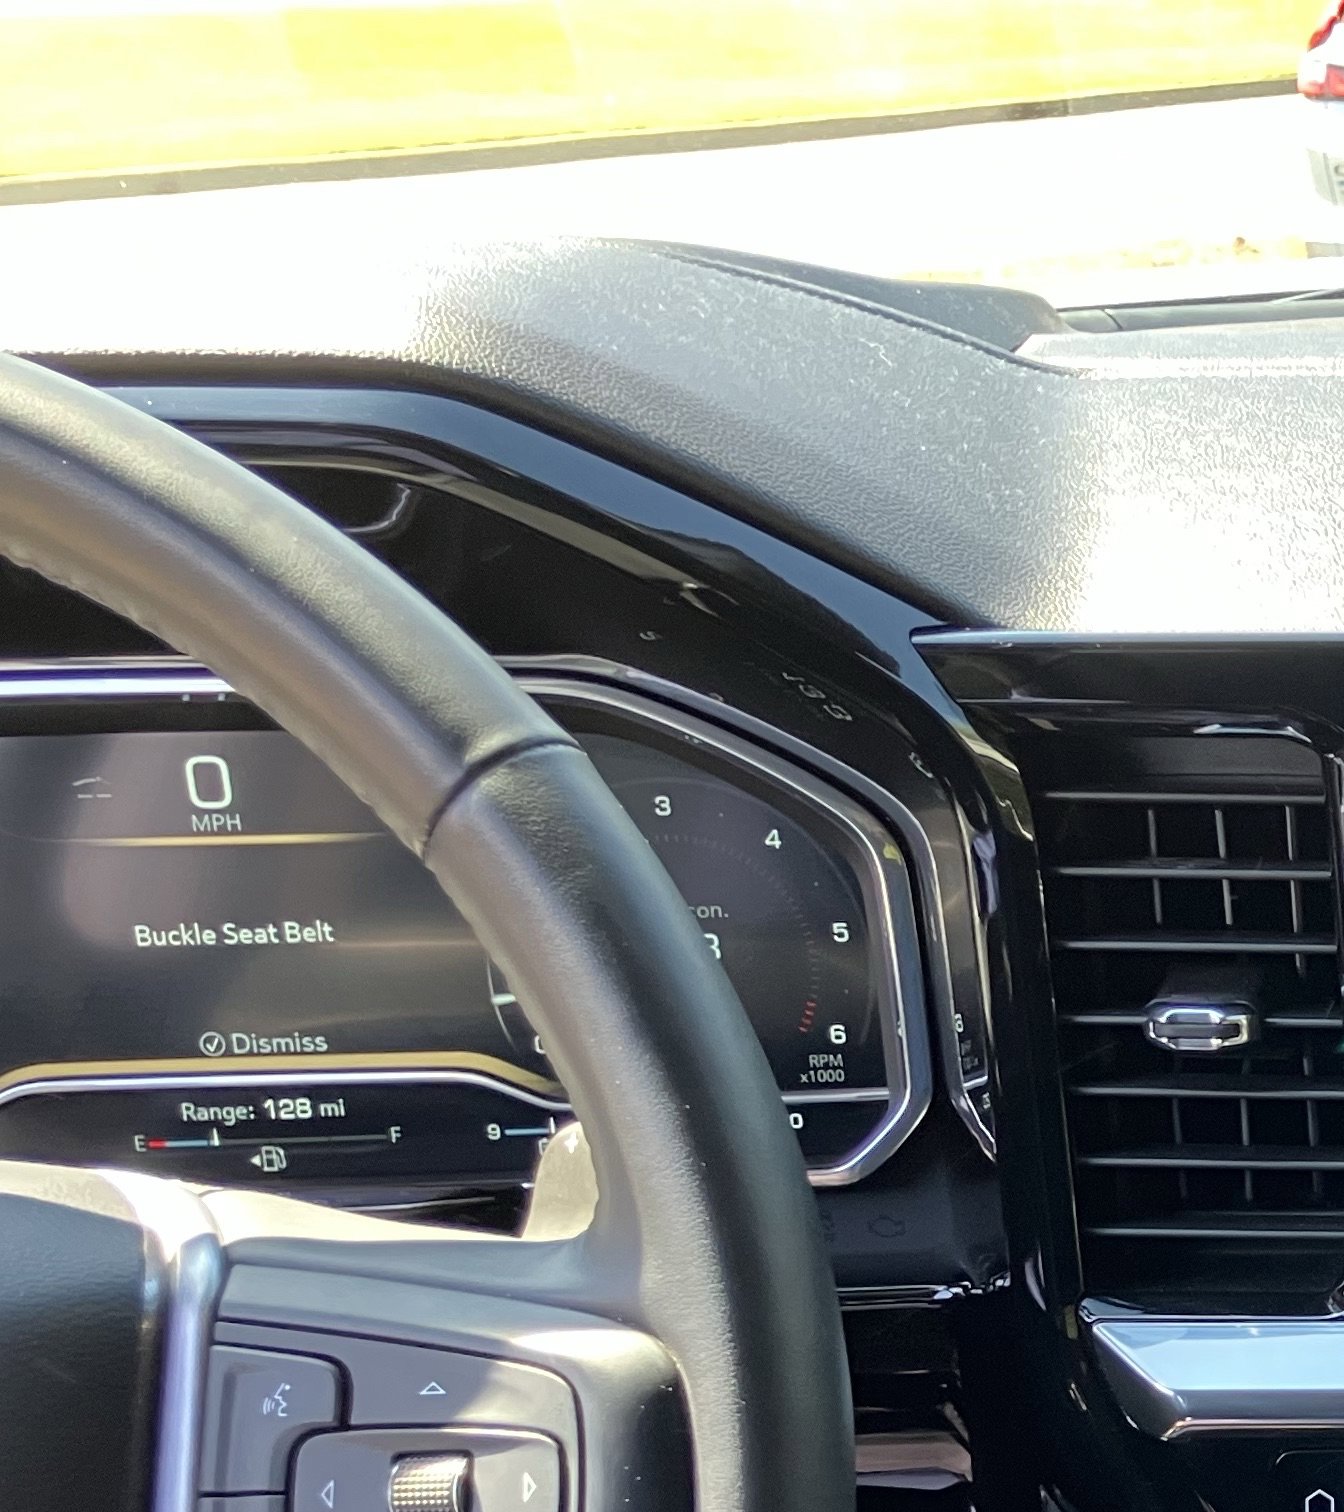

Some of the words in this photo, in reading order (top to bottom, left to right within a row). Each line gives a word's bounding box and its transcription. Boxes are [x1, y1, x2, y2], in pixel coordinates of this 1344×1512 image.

[184, 754, 233, 810] 0
[653, 795, 672, 817] 3
[191, 813, 242, 832] MPH
[764, 829, 782, 850] 4
[133, 922, 217, 948] Buckle
[222, 922, 280, 945] Seat
[283, 919, 335, 944] Belt
[831, 922, 850, 943] 5
[231, 1031, 329, 1055] Dismiss
[829, 1024, 847, 1045] 6
[808, 1053, 844, 1068] RPM
[799, 1068, 845, 1084] x1000
[180, 1101, 256, 1126] Range:
[262, 1098, 313, 1121] 128
[318, 1098, 346, 1118] mi
[390, 1126, 402, 1143] F
[486, 1122, 502, 1141] 9
[134, 1135, 147, 1152] E
